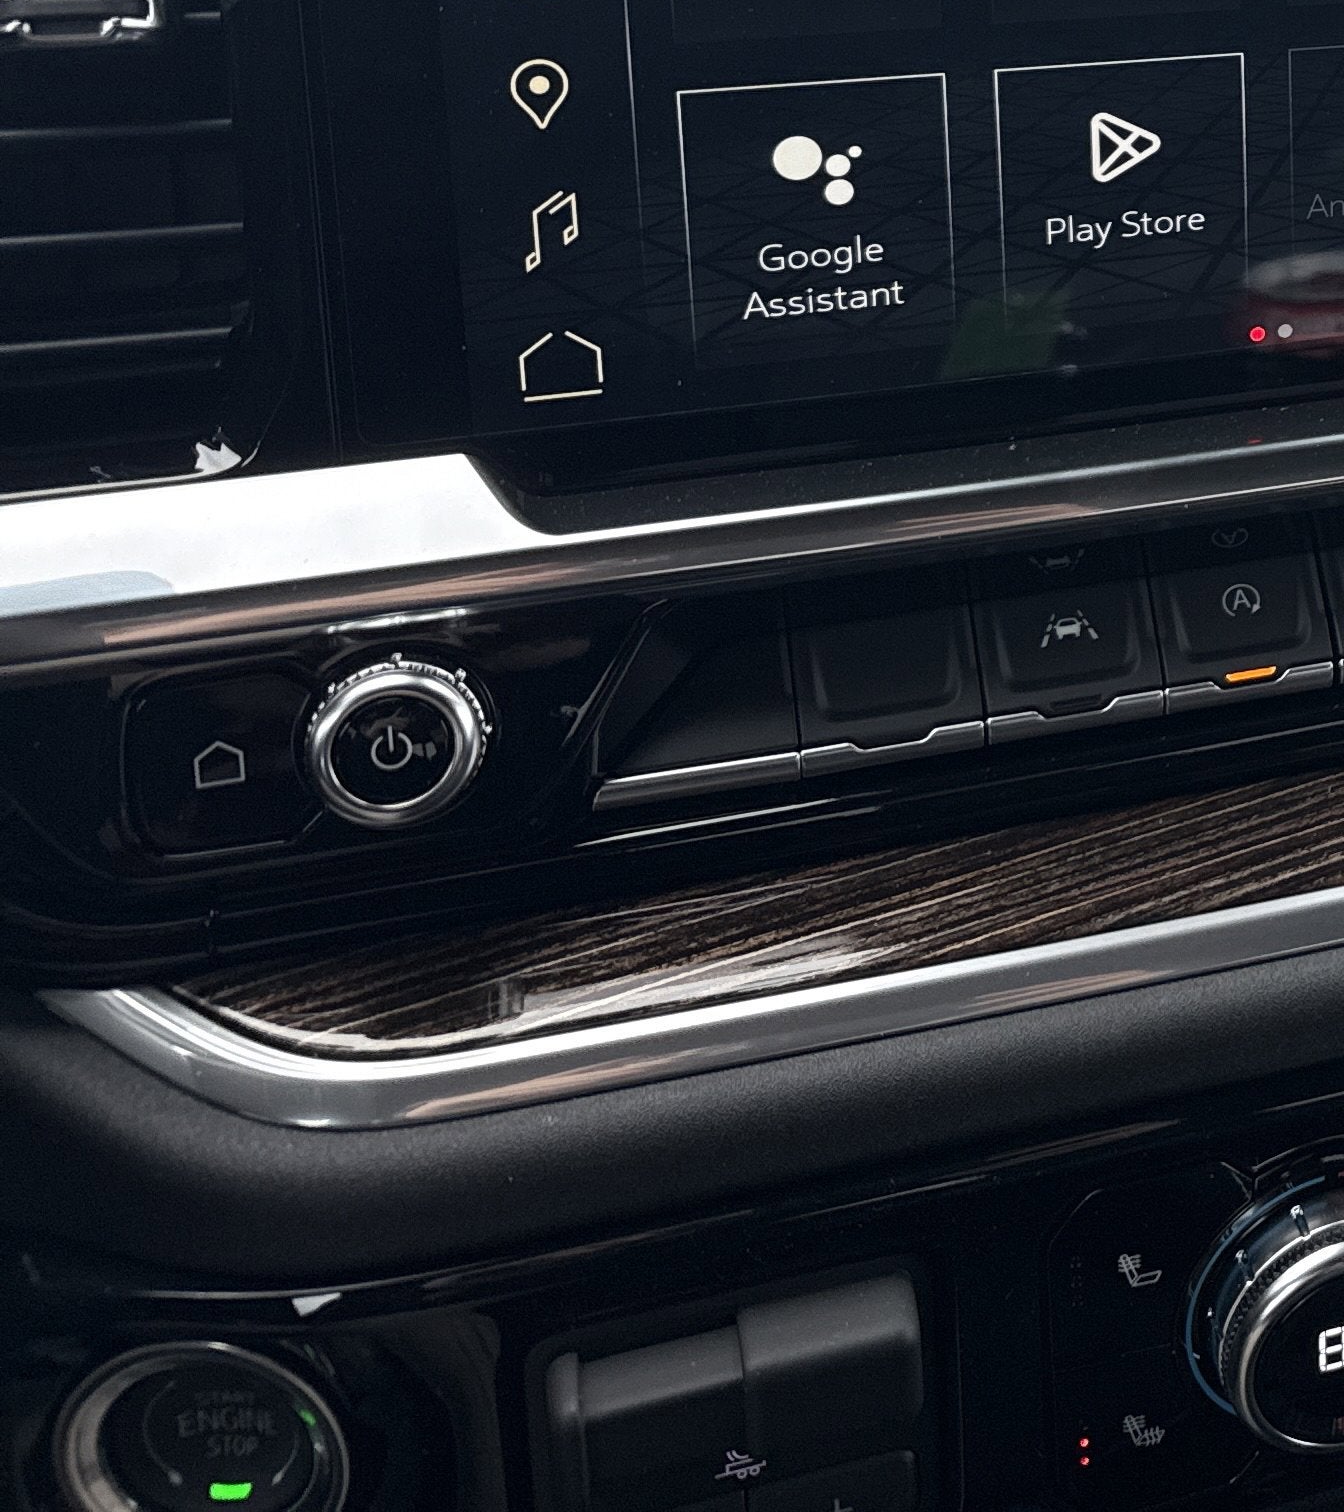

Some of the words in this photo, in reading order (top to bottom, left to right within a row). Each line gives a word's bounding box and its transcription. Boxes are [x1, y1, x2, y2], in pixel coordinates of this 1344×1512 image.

[1046, 214, 1114, 249] Play
[1121, 210, 1206, 238] Store
[758, 234, 885, 274] Google
[743, 280, 905, 320] Assistant
